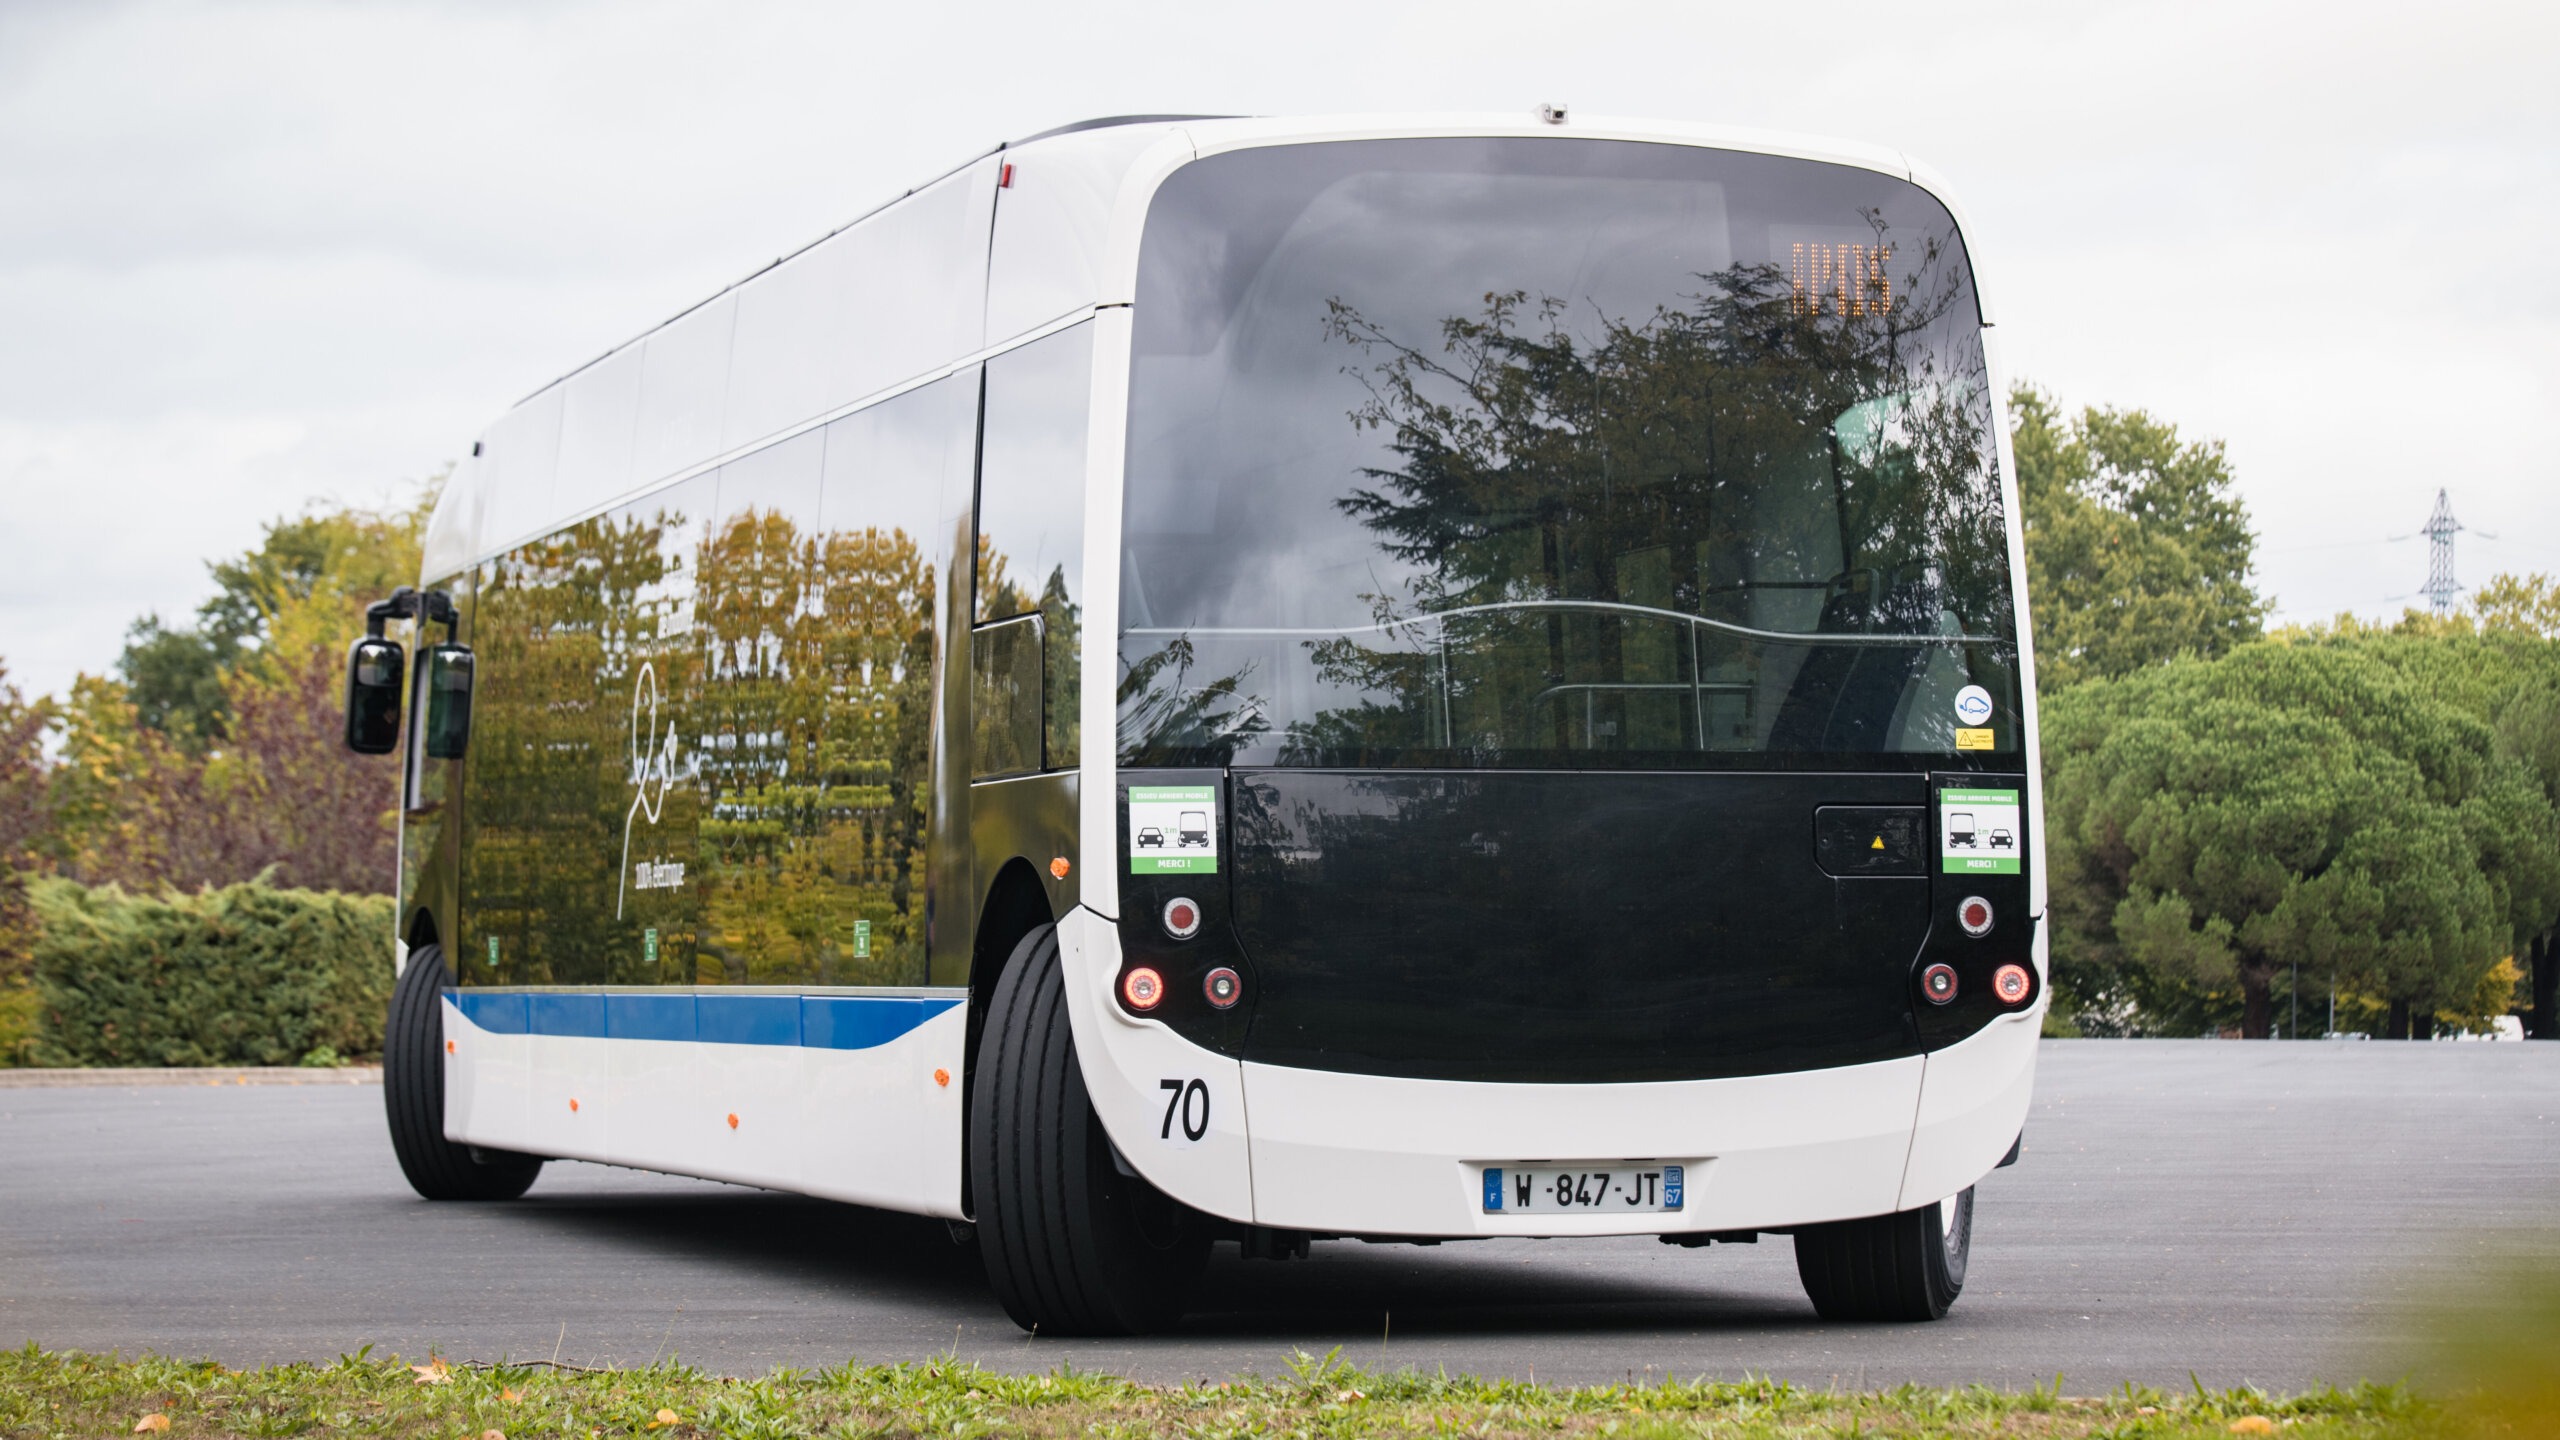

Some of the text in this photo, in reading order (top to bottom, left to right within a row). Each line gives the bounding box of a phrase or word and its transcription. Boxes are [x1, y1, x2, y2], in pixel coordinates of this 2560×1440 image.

[1157, 859, 1185, 868] MERCI
[1966, 860, 1991, 868] MERCI
[1160, 1078, 1210, 1142] 70
[1490, 1192, 1496, 1203] F
[1665, 1188, 1681, 1204] 67
